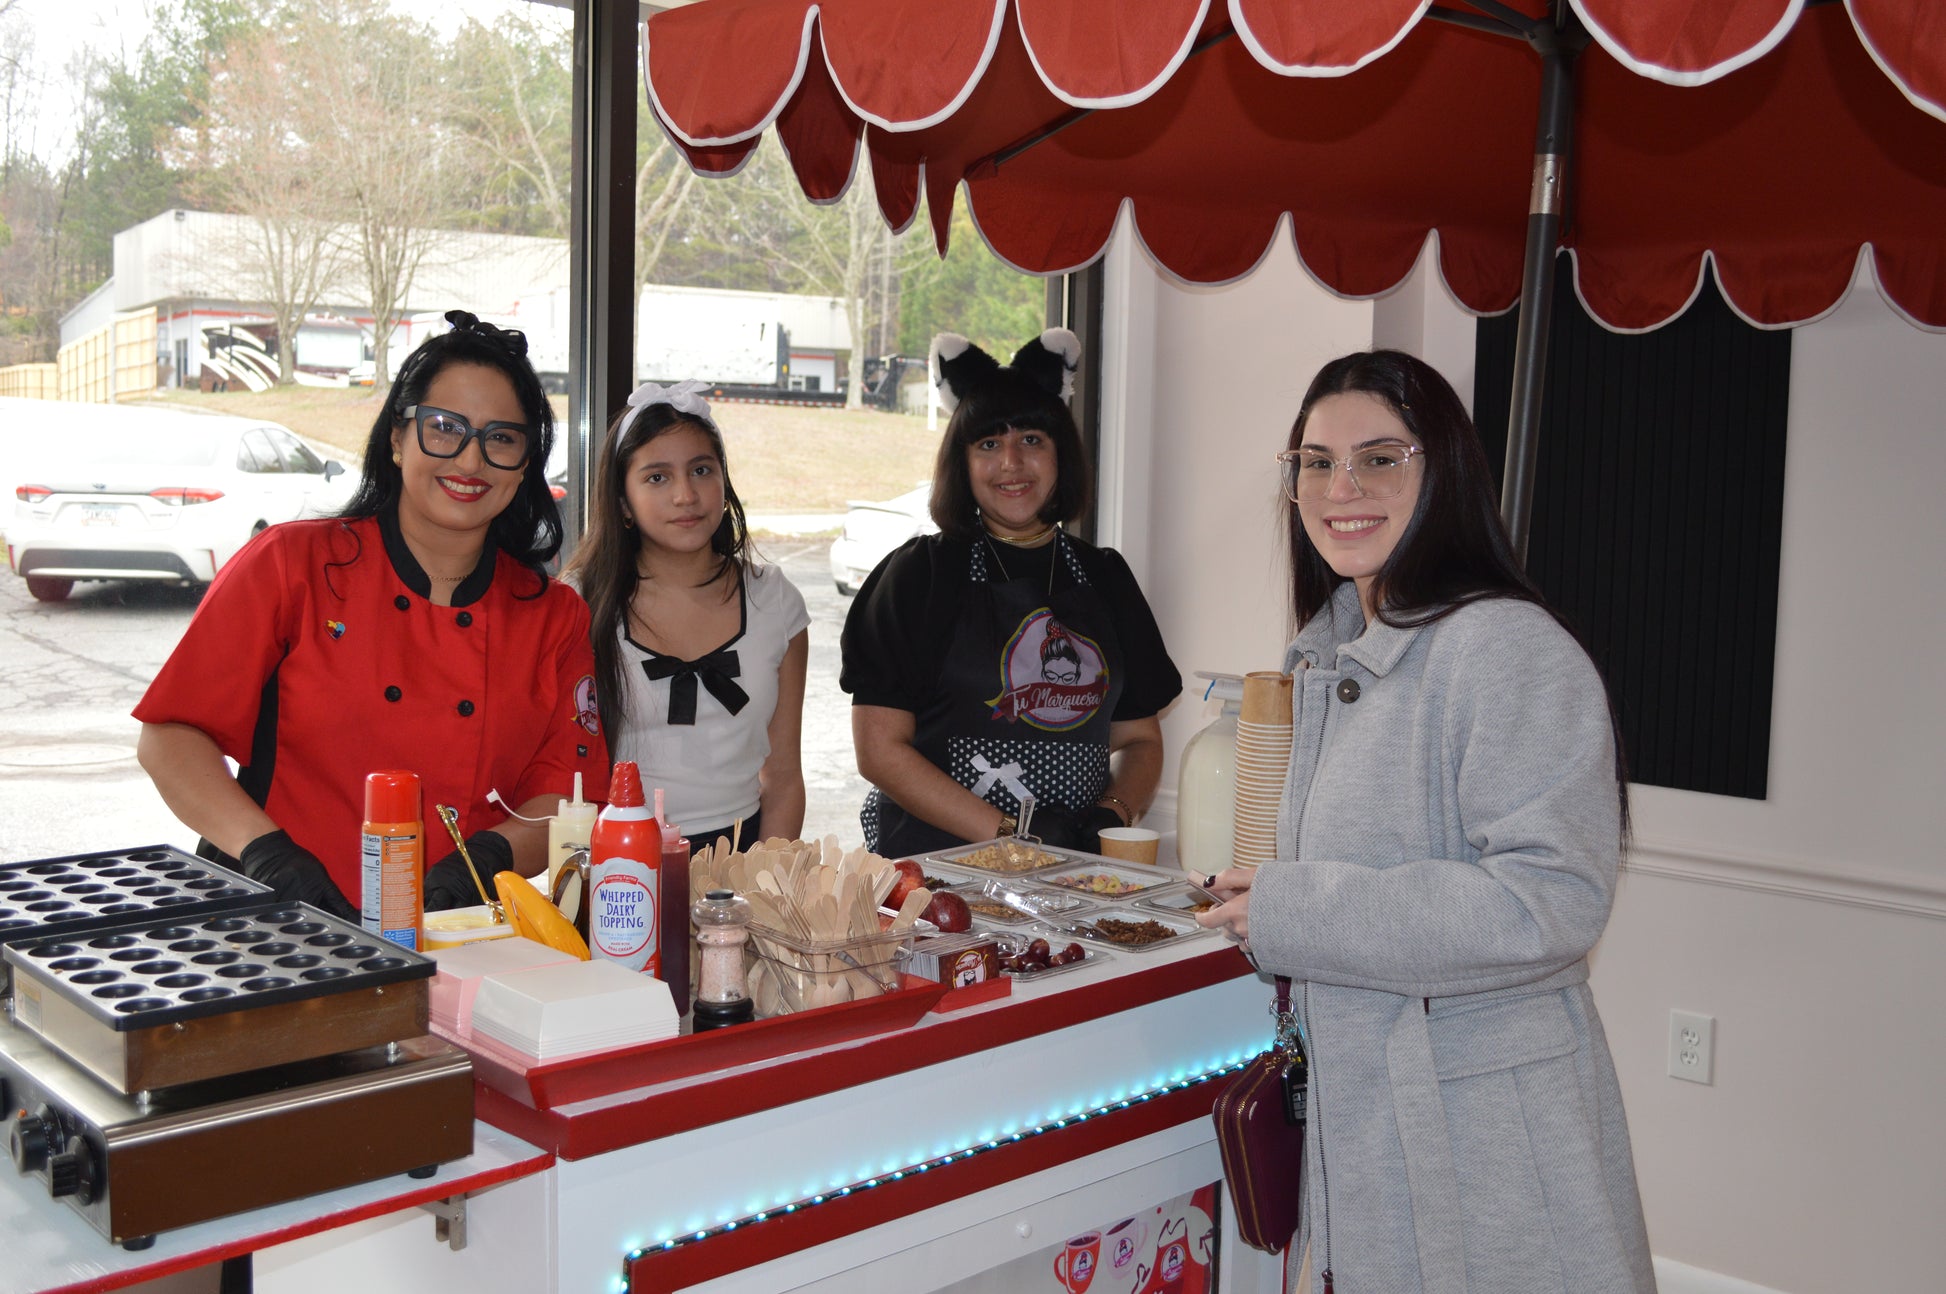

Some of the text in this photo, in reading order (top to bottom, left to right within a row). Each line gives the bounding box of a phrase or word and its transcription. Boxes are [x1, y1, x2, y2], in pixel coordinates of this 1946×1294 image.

[1004, 684, 1031, 717] Tu
[599, 888, 644, 903] WHIPPED
[606, 902, 636, 916] DAIRY
[599, 915, 644, 929] TOPPING
